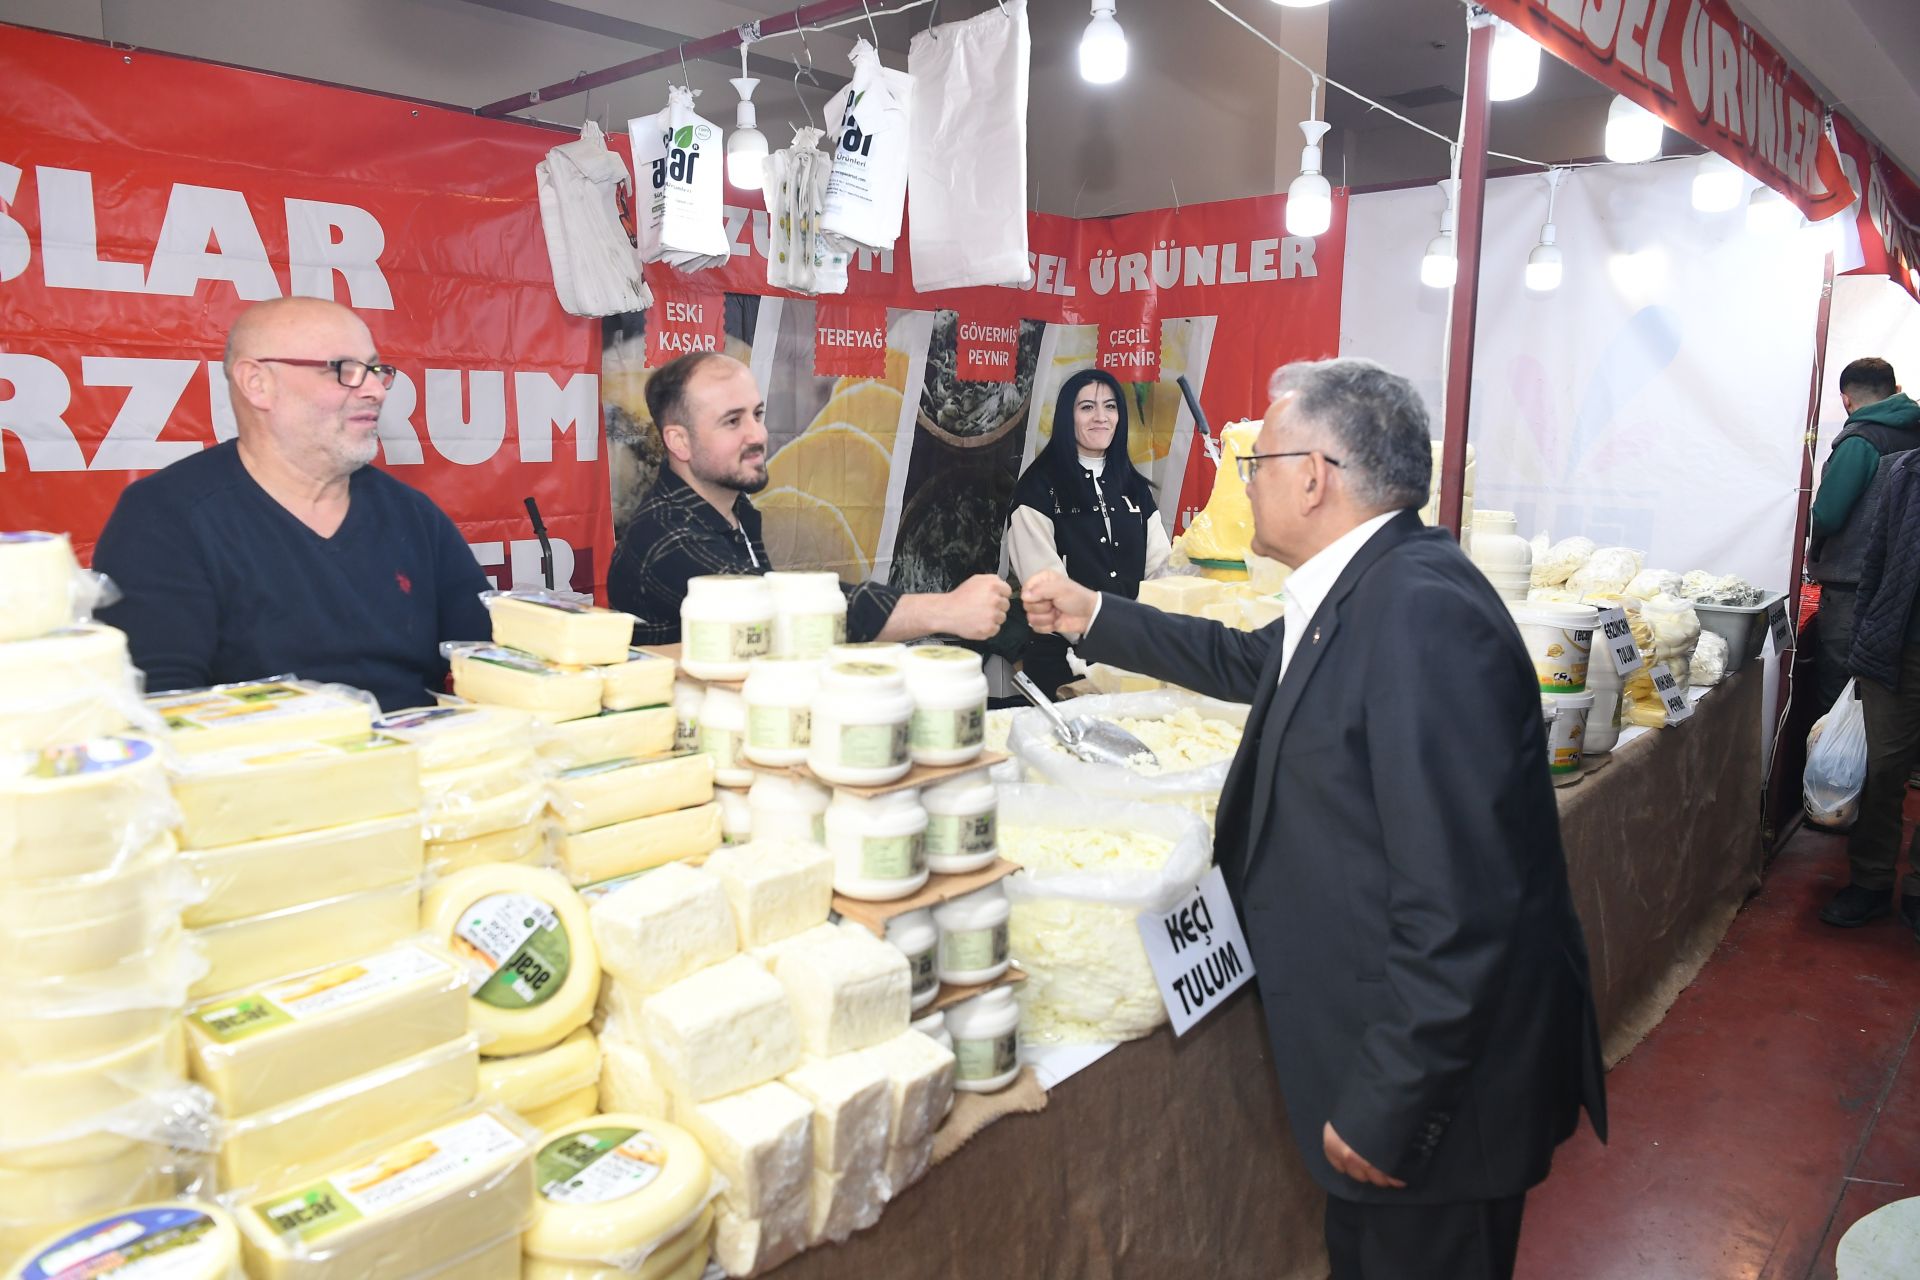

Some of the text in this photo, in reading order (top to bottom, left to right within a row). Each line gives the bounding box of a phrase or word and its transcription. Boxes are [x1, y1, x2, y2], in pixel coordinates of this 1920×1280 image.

[1089, 239, 1318, 296] ÜRÜNLER
[659, 331, 716, 355] KAŞAR
[818, 327, 883, 349] TEREYAĞ
[960, 321, 1018, 347] GÖVERMİŞ
[1103, 346, 1156, 368] PEYNİR
[1616, 644, 1638, 666] TULUM
[1164, 884, 1214, 954] KEÇİ
[506, 952, 551, 990] acar
[1172, 940, 1244, 1016] TULUM
[275, 1194, 337, 1231] acar
